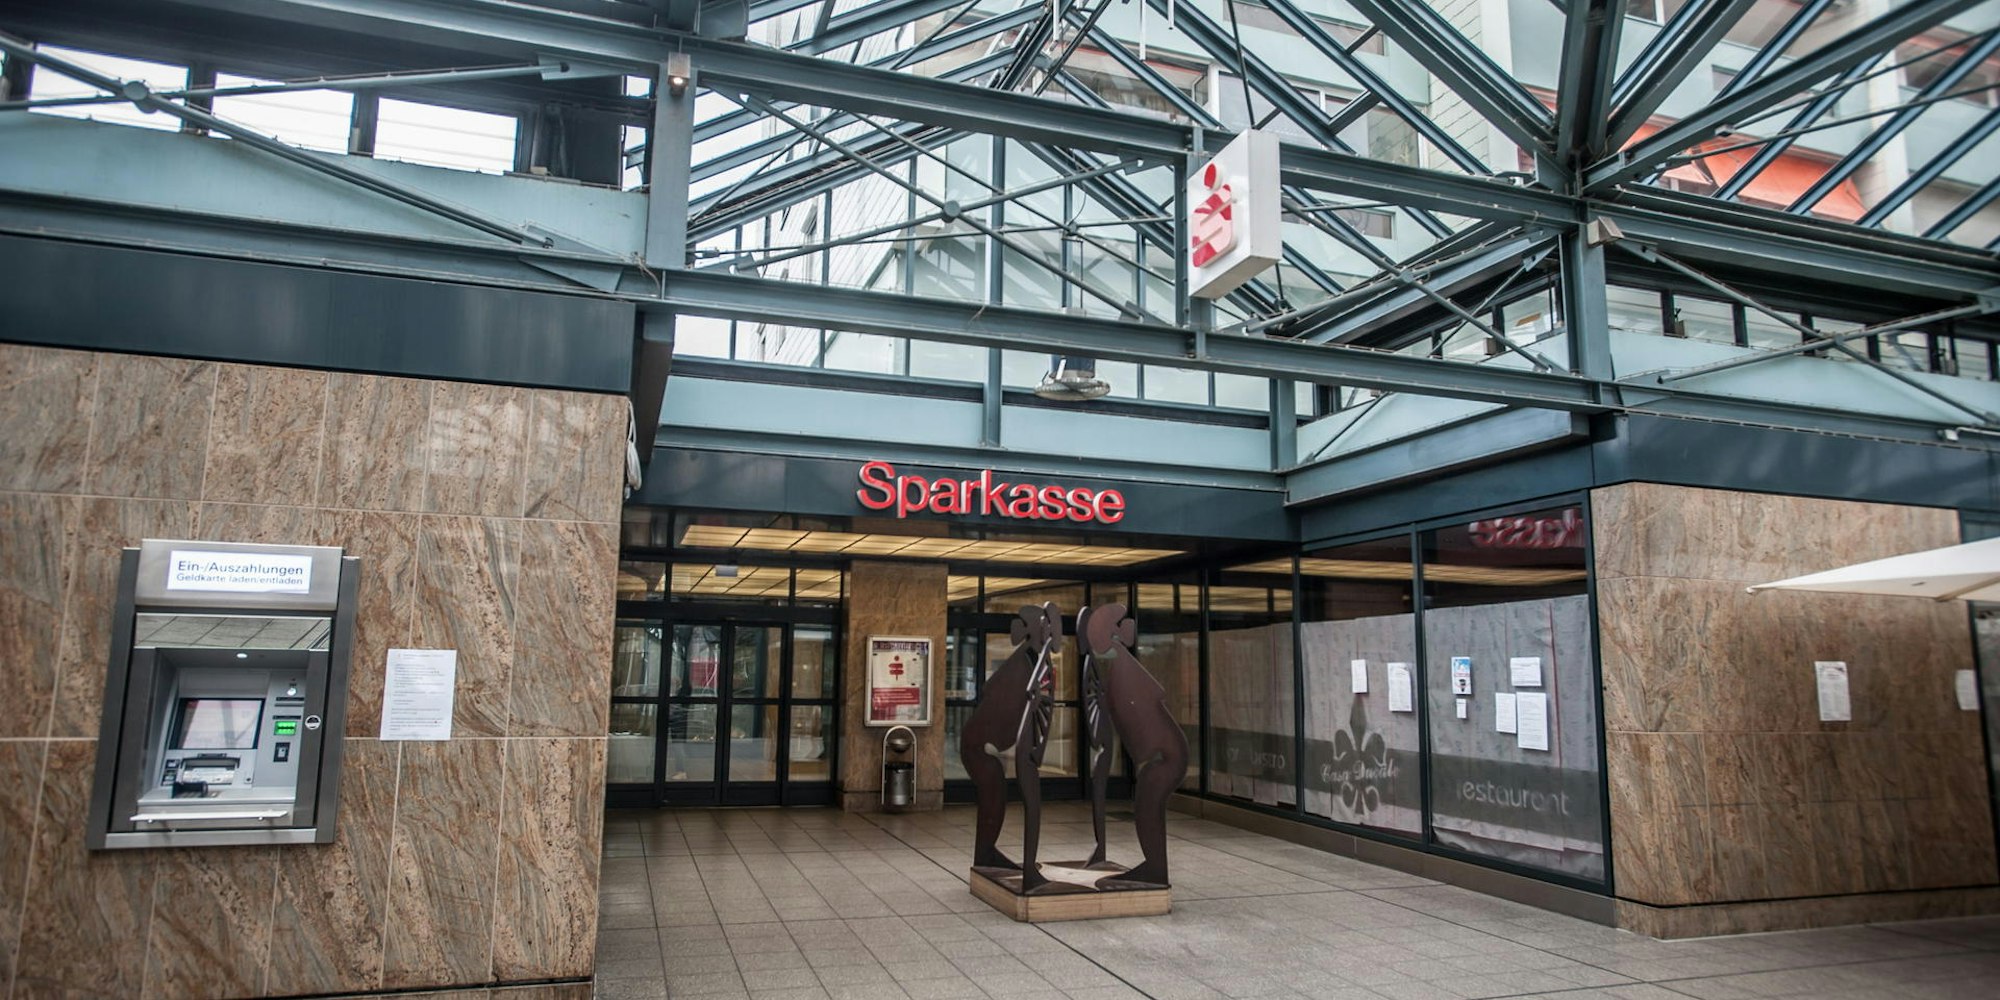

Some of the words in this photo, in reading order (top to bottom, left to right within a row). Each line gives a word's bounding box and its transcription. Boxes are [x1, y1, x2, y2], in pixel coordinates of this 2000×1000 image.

[857, 461, 1125, 523] Sparkasse
[178, 560, 303, 576] Ein-/Auszahlungen
[176, 573, 226, 583] Geldkarte
[229, 576, 303, 585] laden/entladen
